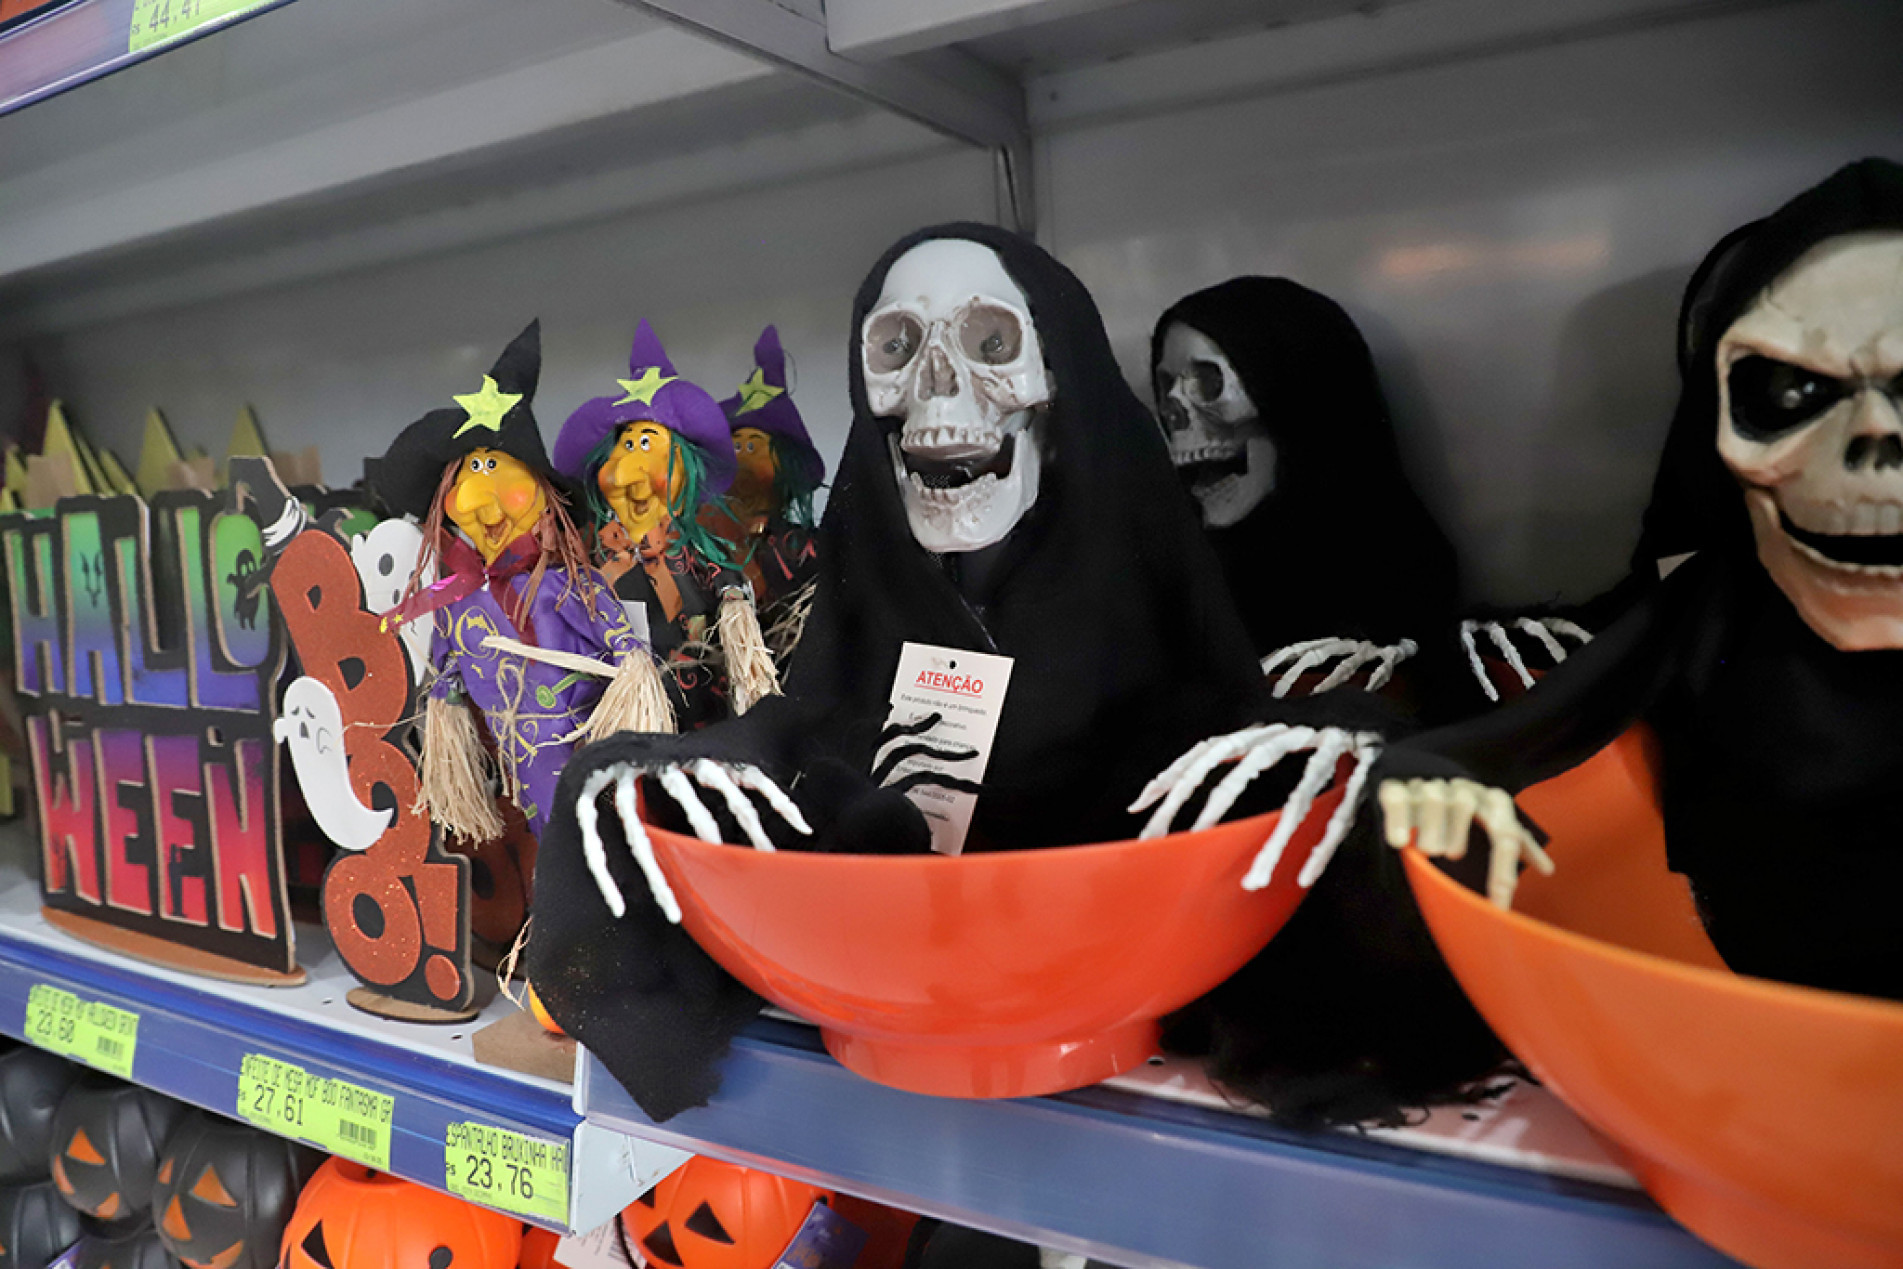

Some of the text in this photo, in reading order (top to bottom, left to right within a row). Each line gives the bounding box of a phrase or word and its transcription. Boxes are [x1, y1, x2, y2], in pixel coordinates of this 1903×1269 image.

[3, 505, 270, 715] HALLO
[916, 670, 984, 694] ATENÇÃO
[27, 716, 277, 940] WEEN
[269, 529, 461, 1001] BOO!
[253, 1084, 304, 1127] 27.61
[466, 1154, 534, 1199] 23.76
